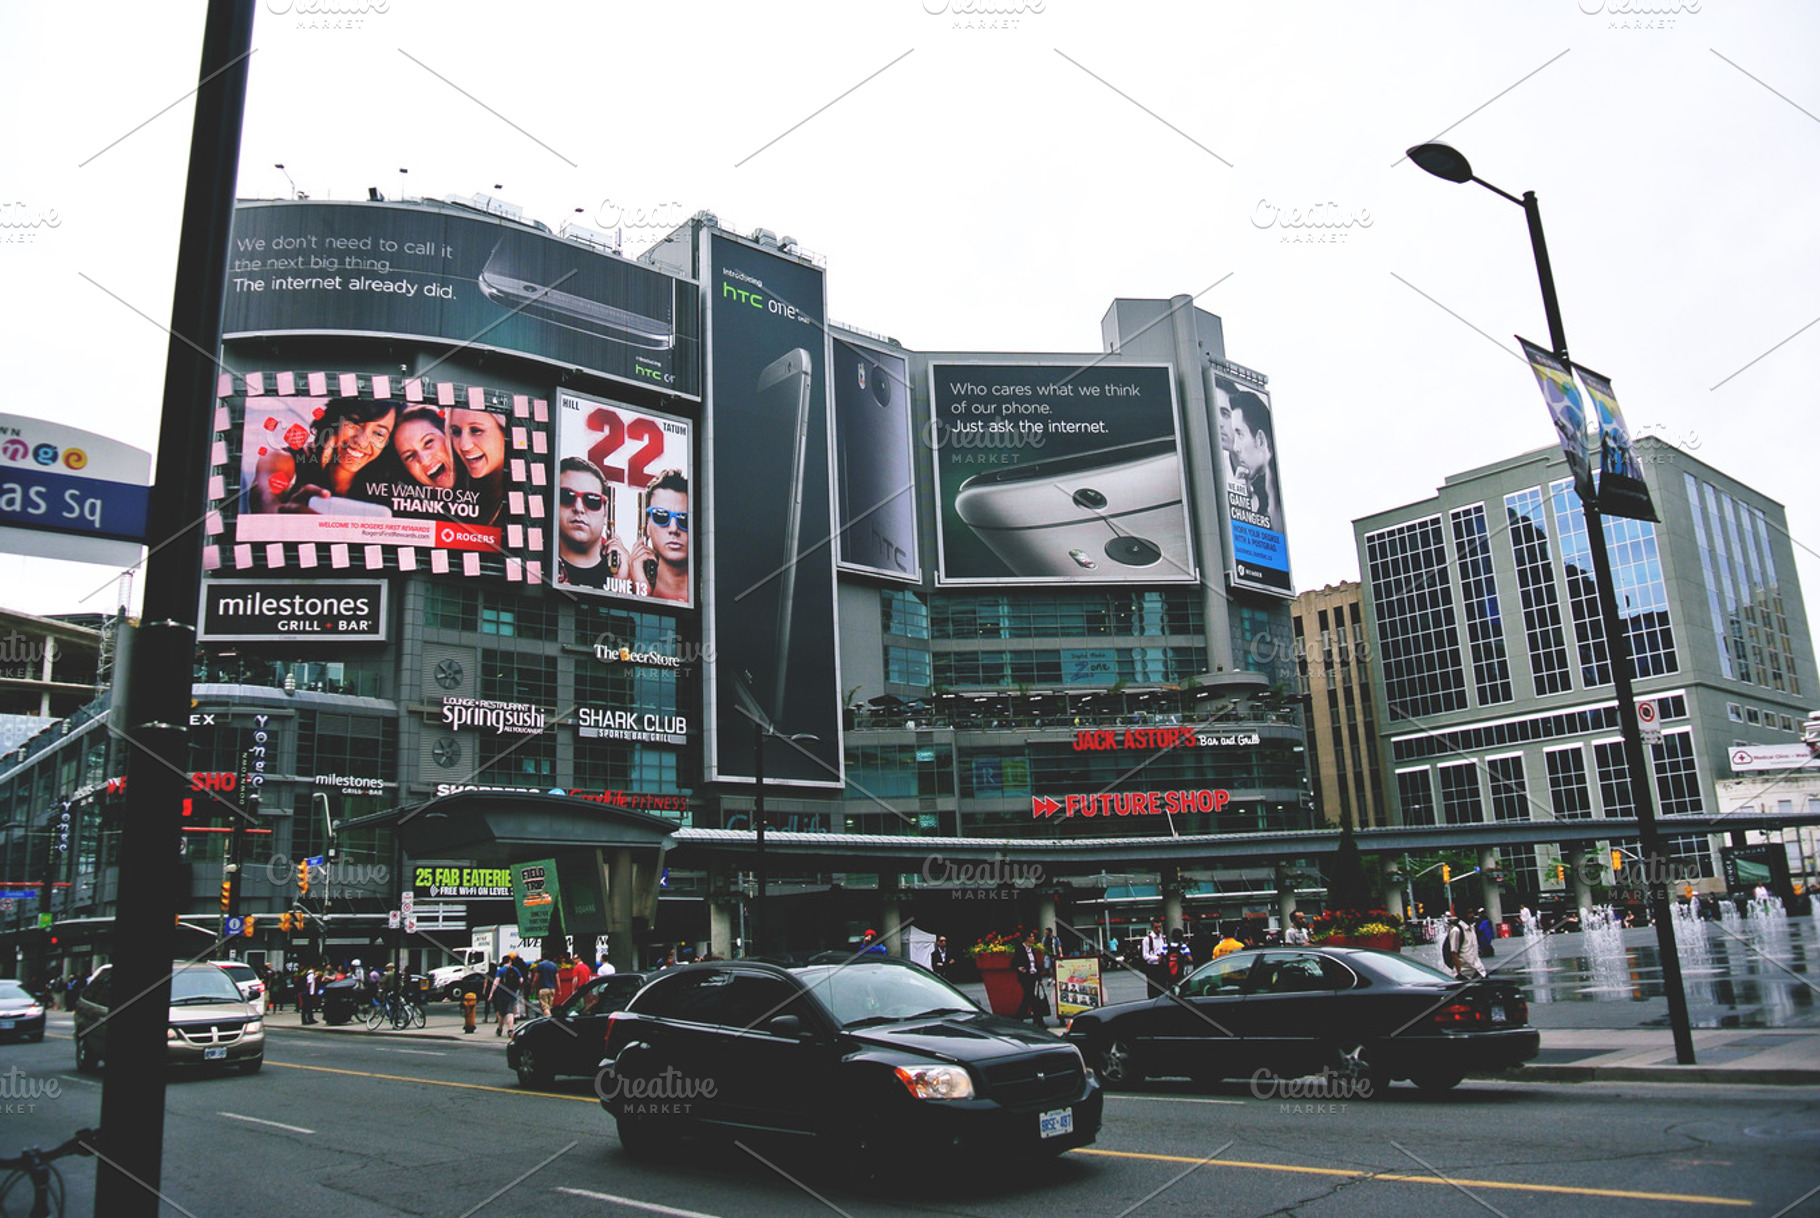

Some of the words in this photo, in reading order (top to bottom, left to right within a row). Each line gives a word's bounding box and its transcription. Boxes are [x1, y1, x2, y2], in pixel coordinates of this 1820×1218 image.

[236, 237, 266, 252] We
[272, 234, 317, 250] don't
[325, 236, 372, 250] need
[380, 238, 398, 252] to
[404, 242, 434, 256] call
[442, 244, 454, 259] it
[234, 258, 262, 272] the
[266, 256, 304, 269] next
[310, 254, 338, 272] big
[232, 278, 265, 292] The
[272, 276, 342, 290] internet
[348, 276, 418, 297] already
[424, 282, 457, 300] did.
[950, 382, 988, 396] Who
[992, 384, 1032, 396] cares
[1036, 382, 1074, 396] what
[1078, 386, 1101, 396] we
[1105, 384, 1141, 396] think
[562, 398, 580, 410] HILL
[951, 401, 968, 414] of
[972, 404, 997, 414] our
[1002, 402, 1052, 416] phone.
[662, 422, 687, 436] TATUM
[952, 420, 984, 434] Just
[989, 420, 1014, 434] ask
[1018, 420, 1044, 434] the
[1049, 420, 1109, 434] internet.
[587, 408, 664, 488] 22
[366, 482, 388, 497] WE
[392, 484, 432, 500] WANT
[435, 486, 454, 502] TO
[456, 489, 480, 504] SAY
[62, 489, 102, 528] Sq
[391, 498, 444, 514] THANK
[450, 503, 480, 518] YOU
[1231, 507, 1271, 529] CHANGERS
[456, 532, 495, 544] ROGERS
[603, 577, 633, 594] JUNE
[635, 582, 648, 597] 13
[218, 592, 370, 616] milestones
[277, 620, 322, 631] GRILL
[338, 620, 368, 631] BAR
[580, 708, 638, 730] SHARK
[644, 714, 686, 734] CLUB
[1074, 730, 1118, 751] JACK
[1124, 727, 1196, 750] ASTOR'S
[316, 773, 384, 788] milestones
[632, 796, 688, 810] FITNESS
[1066, 793, 1162, 817] FUTURE
[1164, 790, 1230, 814] SHOP
[416, 868, 434, 887] 25
[436, 868, 460, 887] FAB
